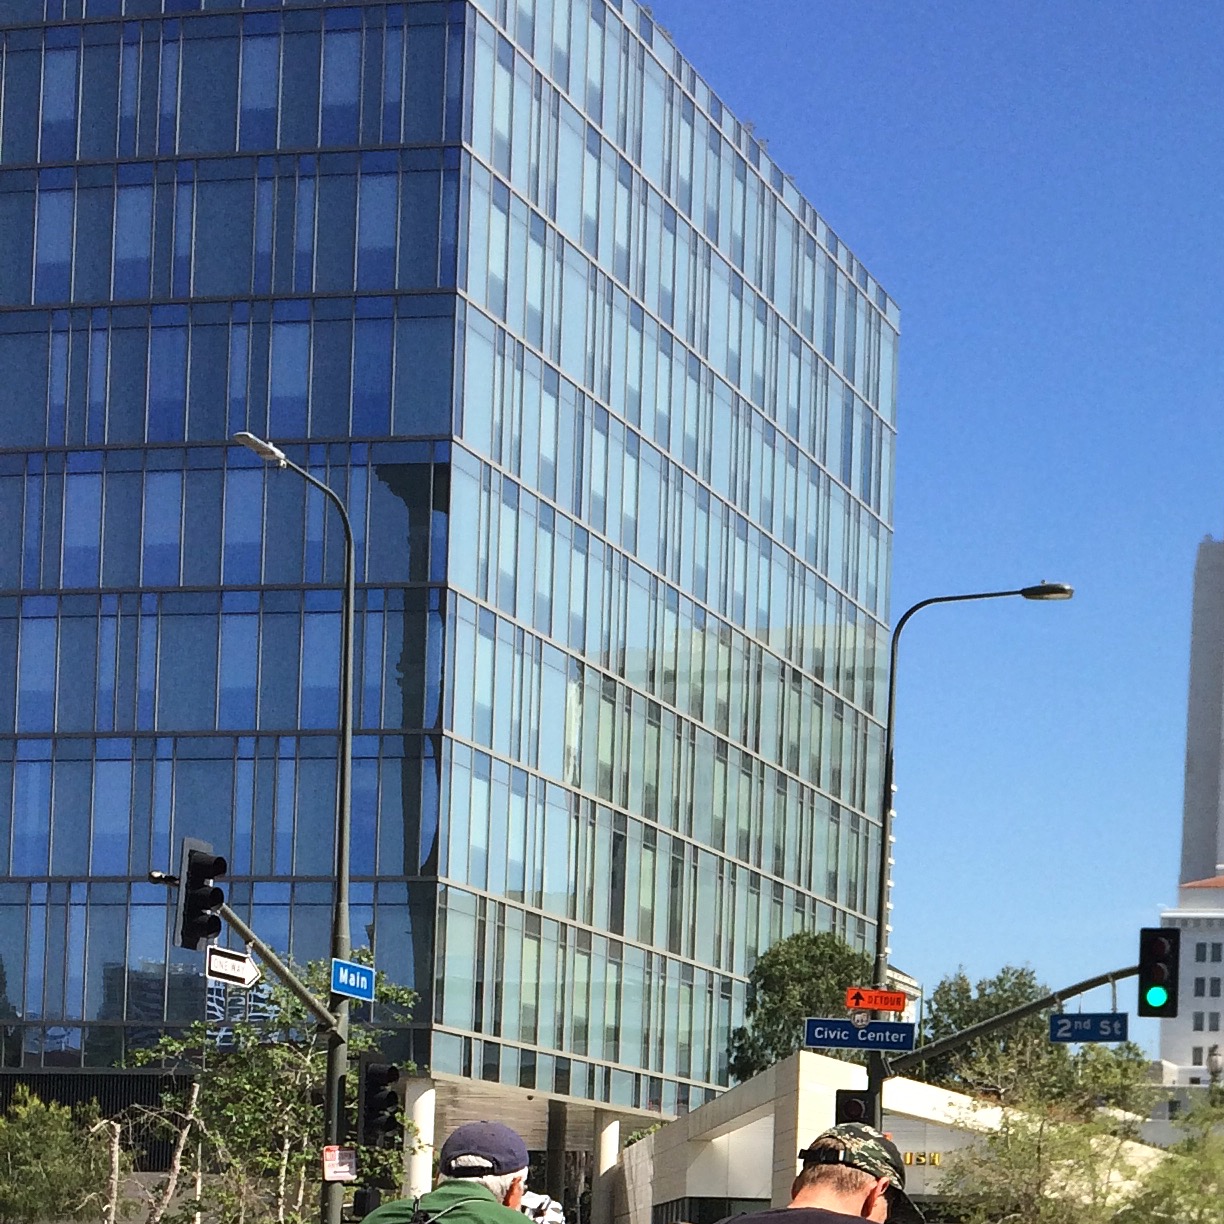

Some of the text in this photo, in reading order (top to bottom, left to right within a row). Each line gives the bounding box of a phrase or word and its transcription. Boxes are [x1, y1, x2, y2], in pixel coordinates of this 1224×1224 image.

[213, 957, 228, 971] ONE
[339, 966, 368, 990] Main
[867, 995, 902, 1006] DETOUR
[814, 1027, 906, 1043] Civic Center
[1056, 1018, 1122, 1038] 2nd St
